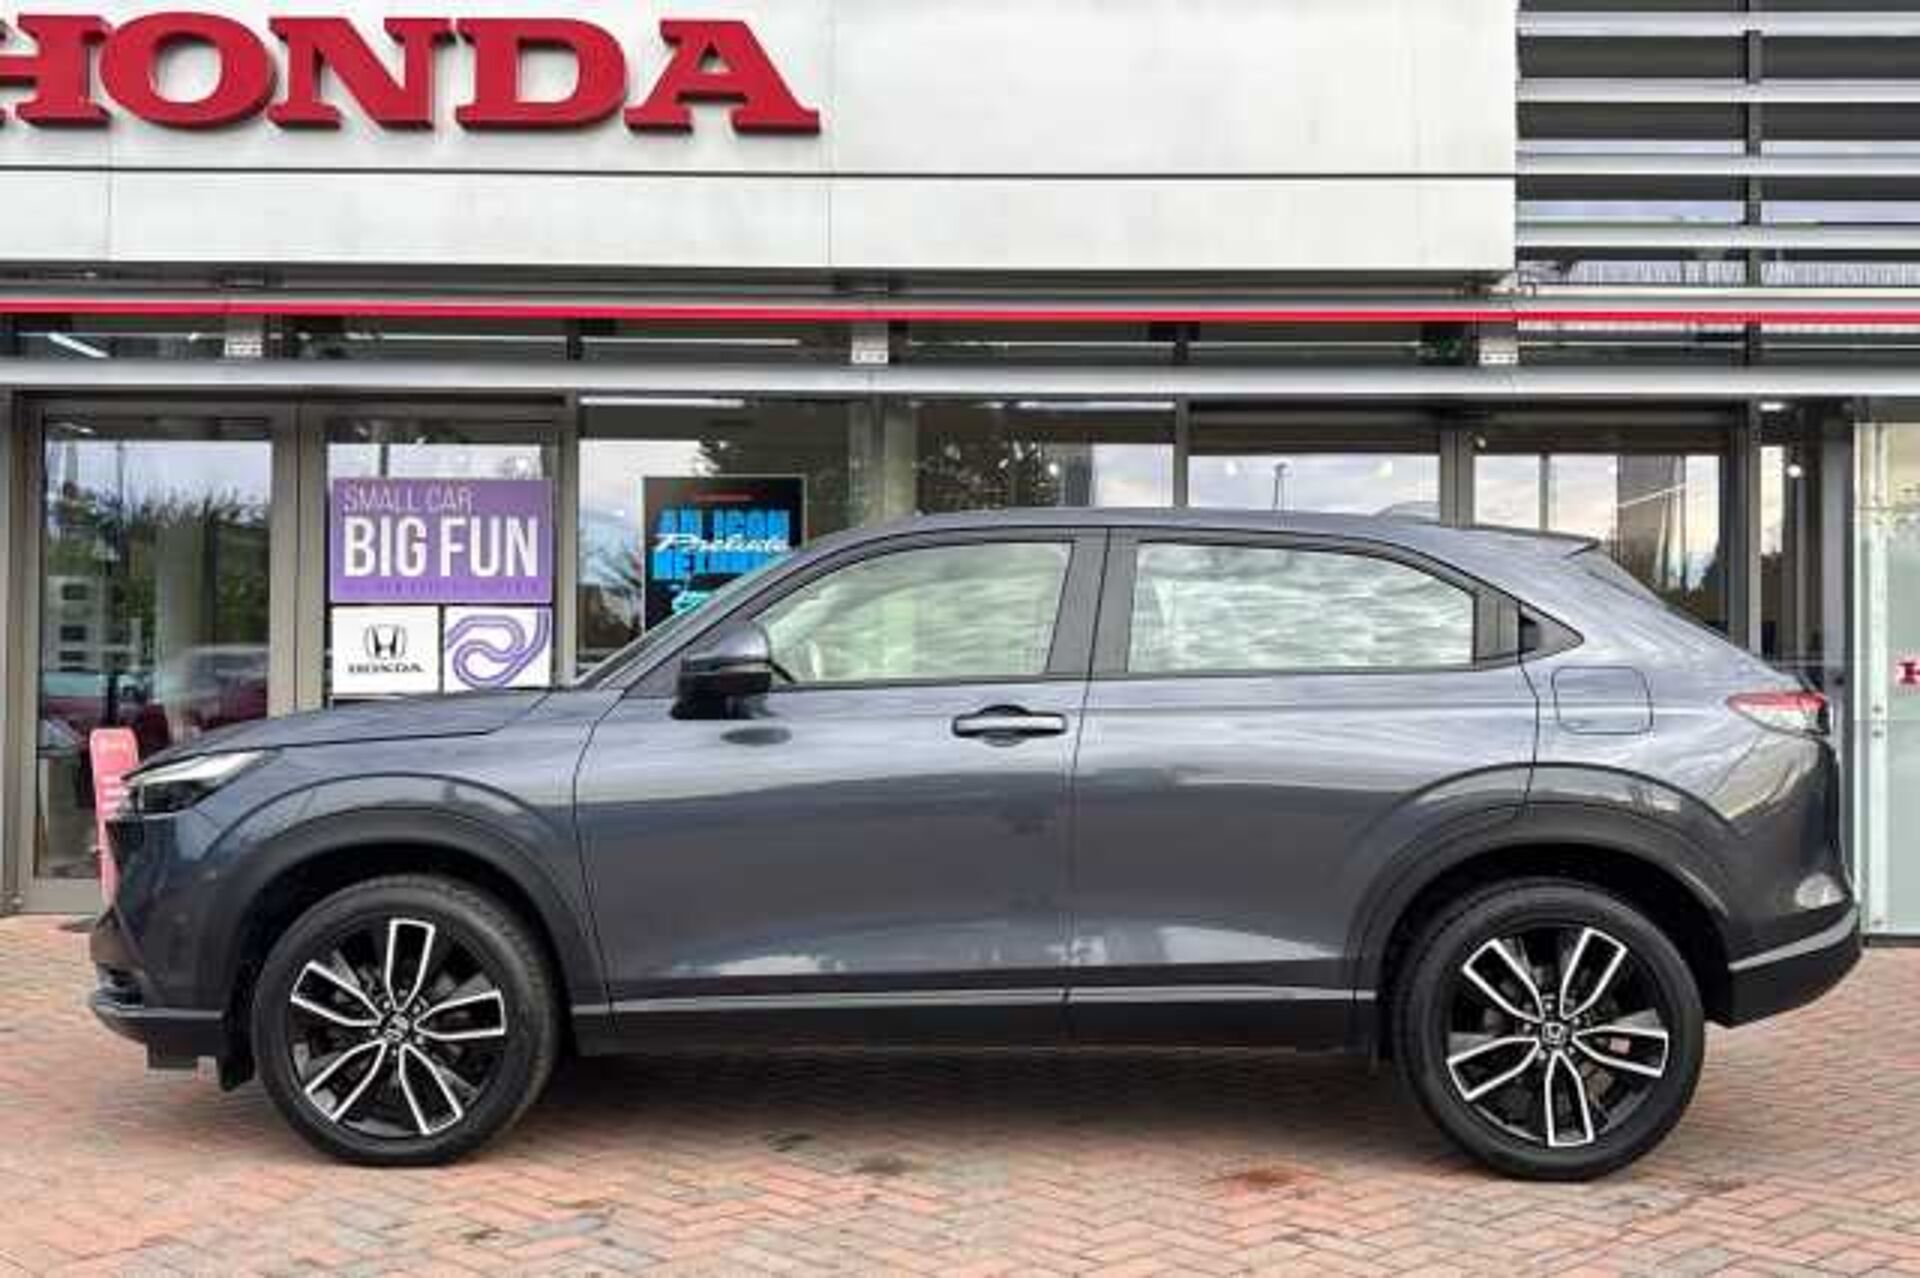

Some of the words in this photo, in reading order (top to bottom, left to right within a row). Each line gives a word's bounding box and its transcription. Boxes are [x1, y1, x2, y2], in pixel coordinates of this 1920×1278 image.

[343, 485, 420, 513] SMALL
[425, 485, 473, 513] CAR
[343, 515, 428, 577] BIG
[440, 515, 539, 578] FUN
